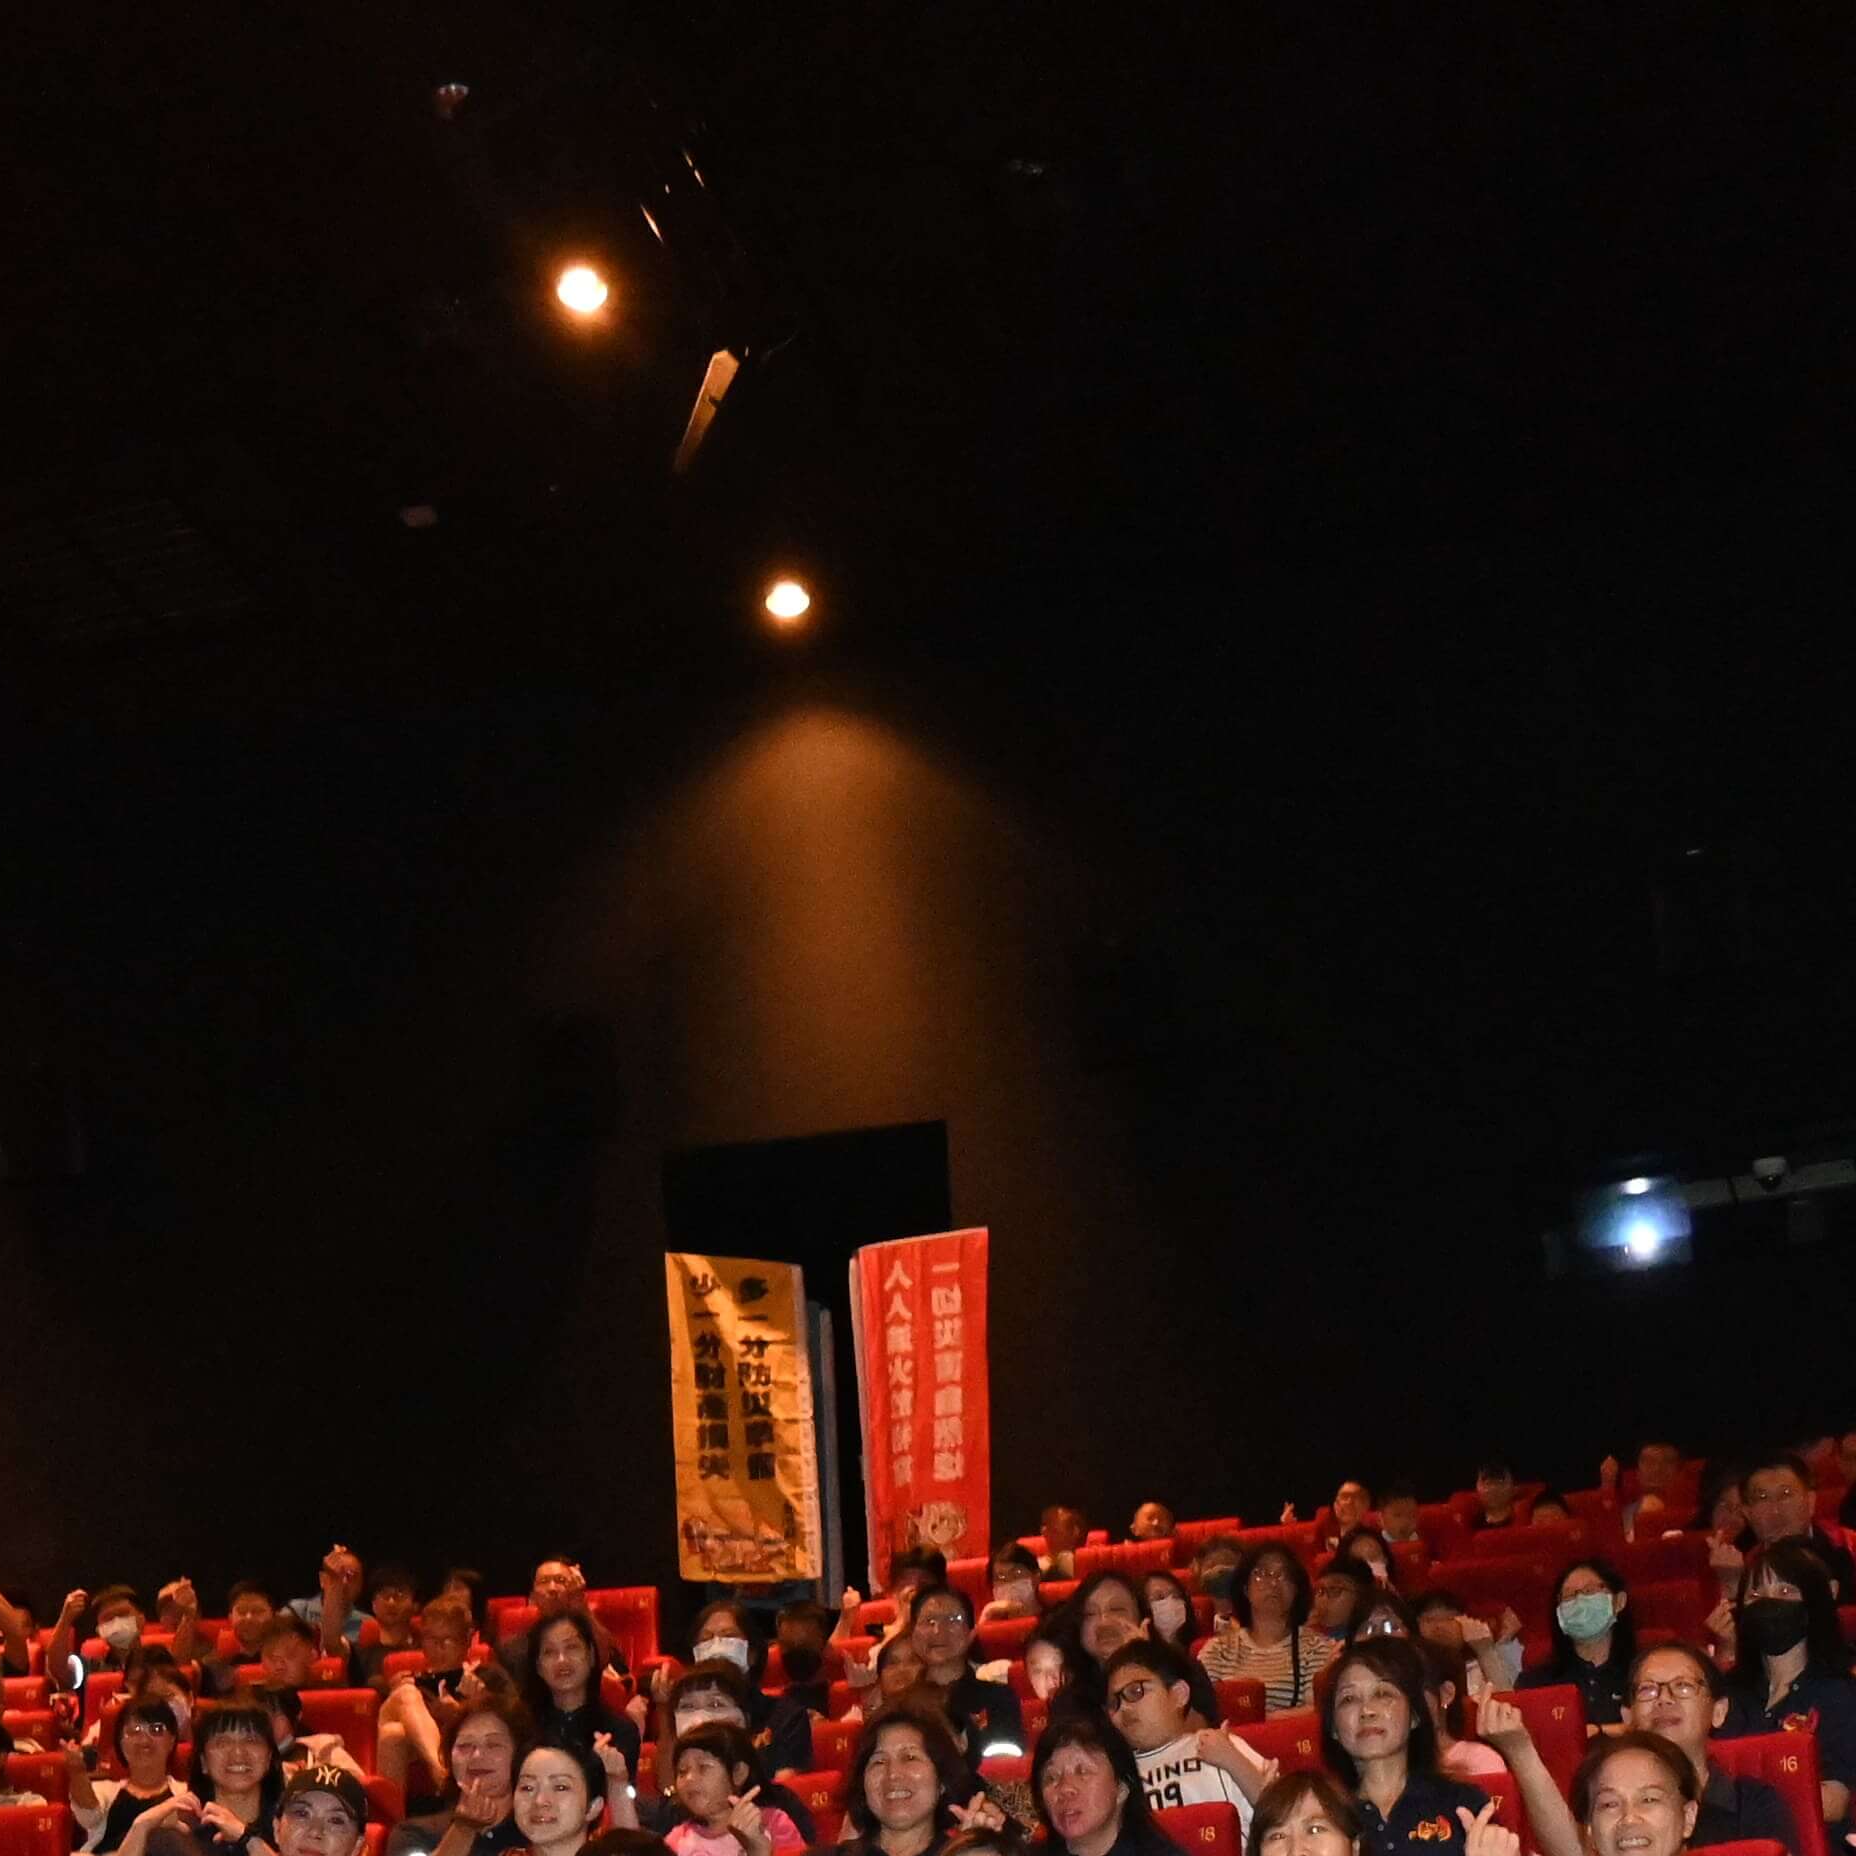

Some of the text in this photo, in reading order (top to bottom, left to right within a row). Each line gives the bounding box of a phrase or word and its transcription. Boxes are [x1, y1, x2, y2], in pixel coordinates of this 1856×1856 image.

[1551, 1706, 1565, 1722] 17
[1780, 1755, 1798, 1773] 16
[1197, 1825, 1217, 1842] 18
